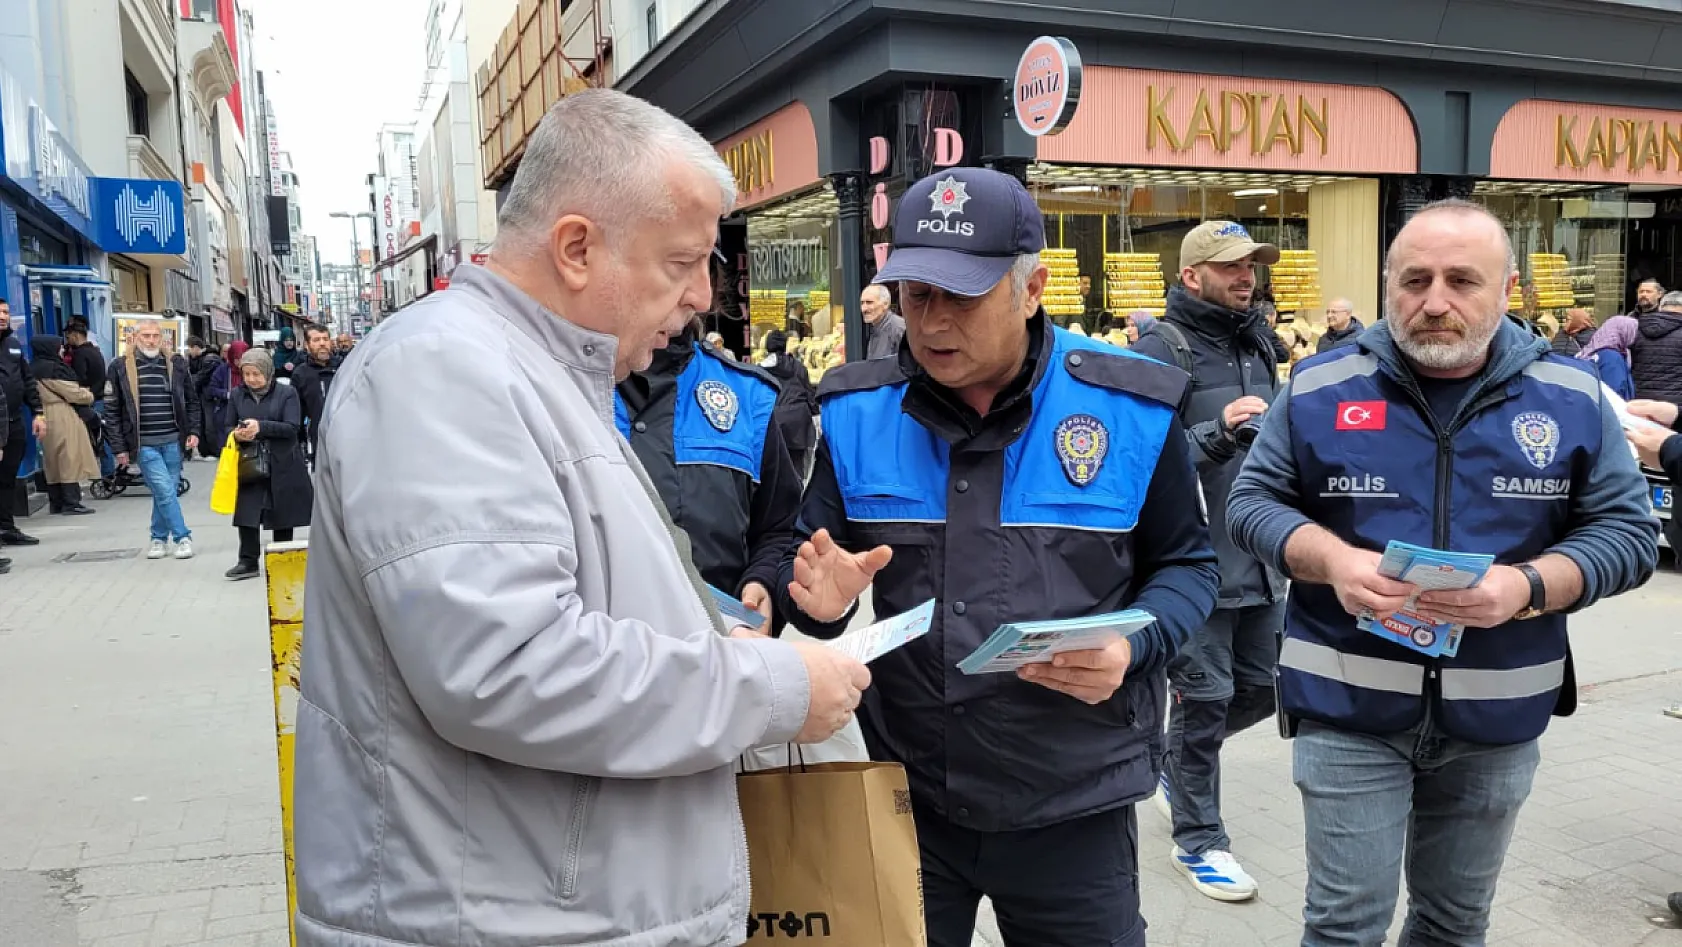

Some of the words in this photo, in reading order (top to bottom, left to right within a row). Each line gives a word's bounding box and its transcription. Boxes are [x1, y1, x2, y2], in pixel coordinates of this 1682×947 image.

[1146, 85, 1328, 156] KAPTAN
[1555, 114, 1682, 173] KAPTAN
[1327, 472, 1386, 491] POLİS
